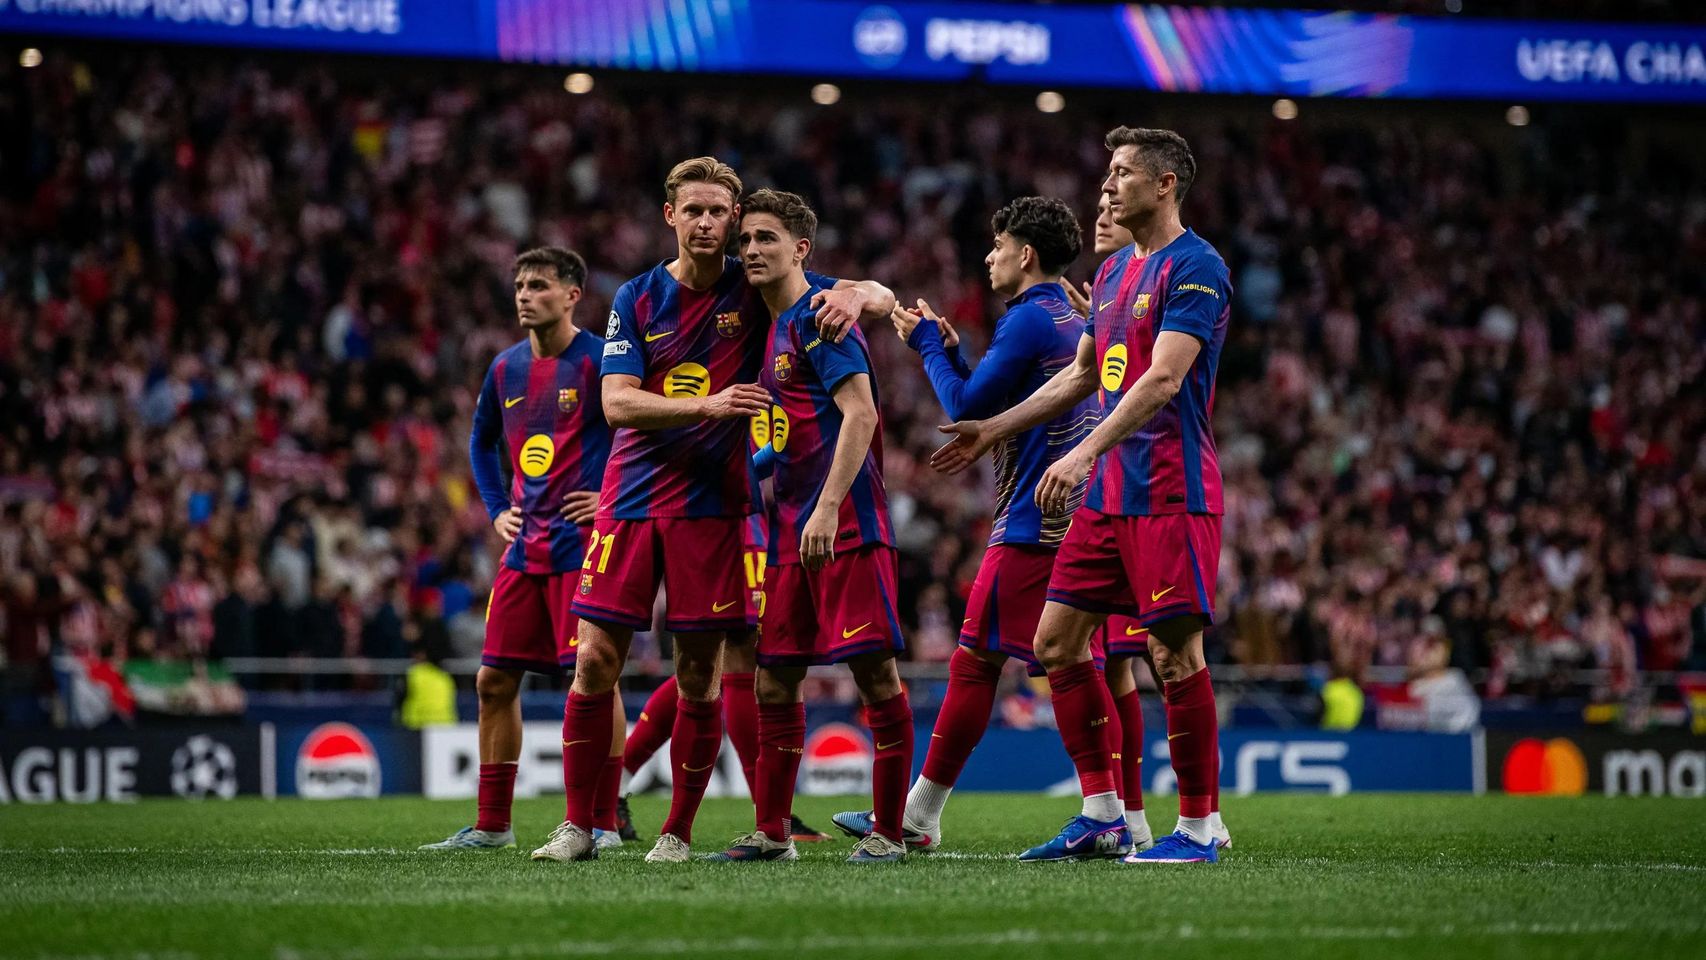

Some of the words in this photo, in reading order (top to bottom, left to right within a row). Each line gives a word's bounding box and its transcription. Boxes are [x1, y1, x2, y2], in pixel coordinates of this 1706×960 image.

[926, 18, 1050, 65] PEPSI
[1516, 38, 1620, 82] UEFA
[1178, 283, 1216, 296] AMBILIGHT
[582, 529, 616, 574] 21
[0, 746, 140, 804] GUE
